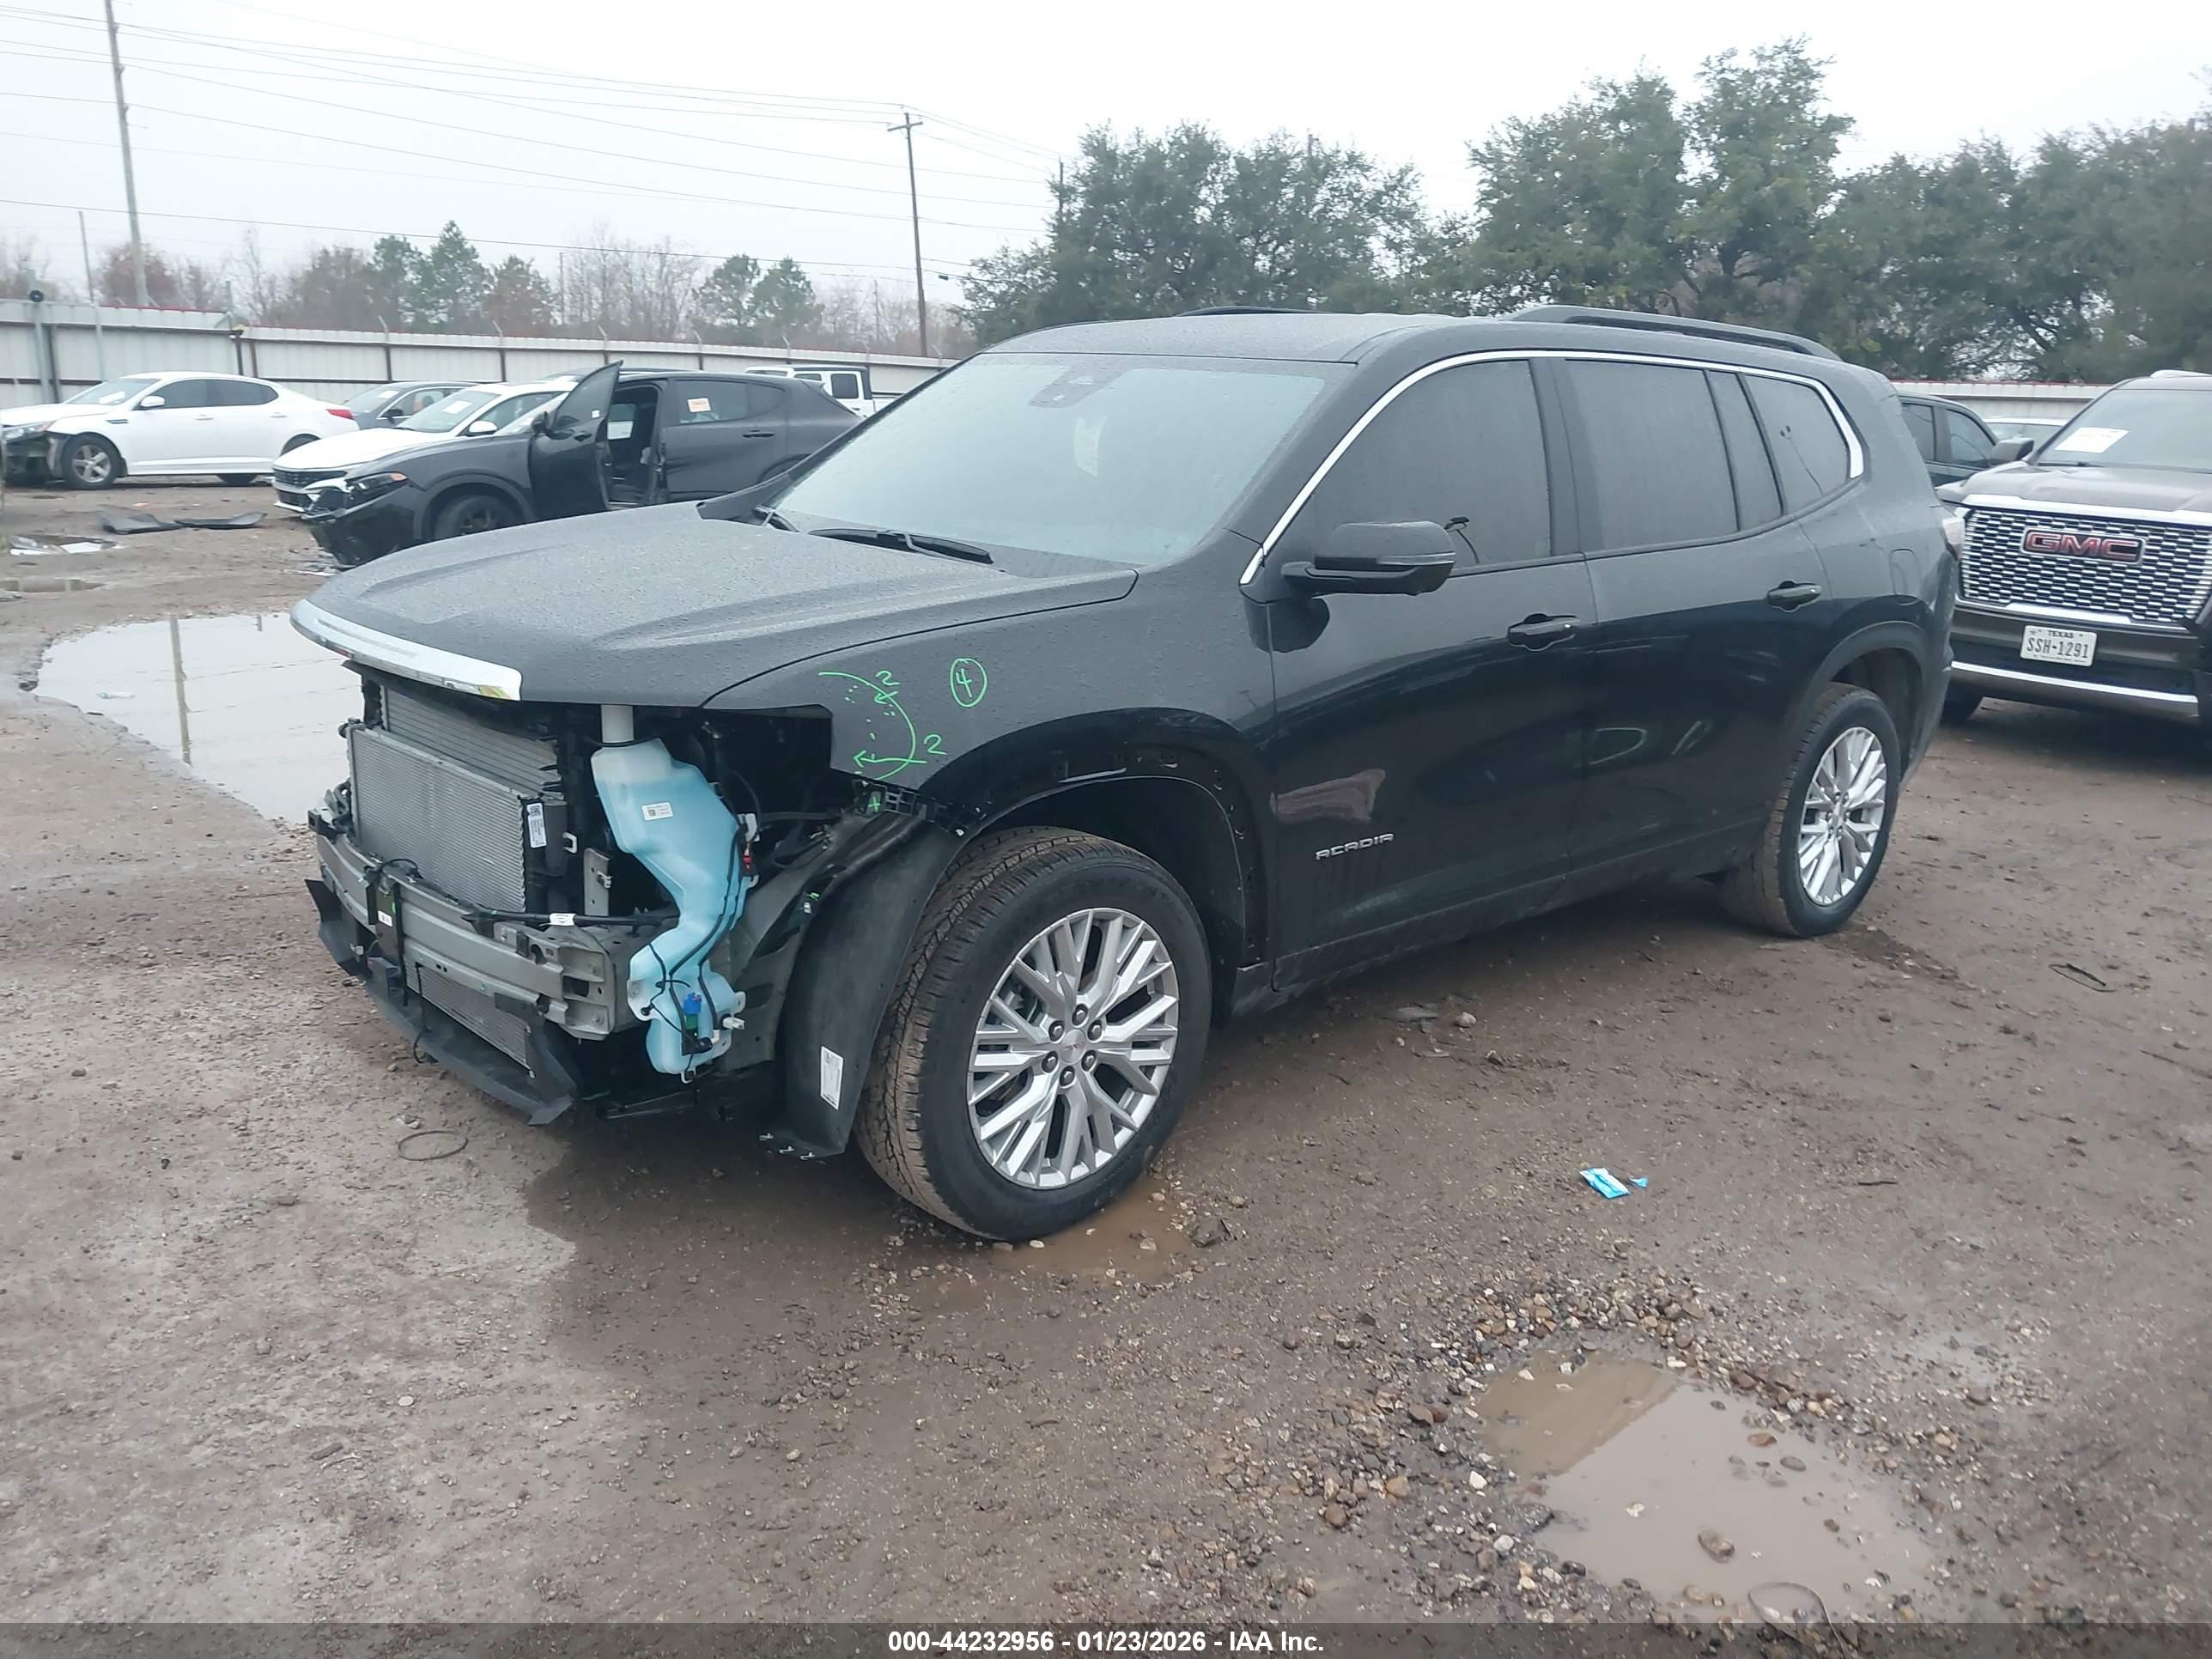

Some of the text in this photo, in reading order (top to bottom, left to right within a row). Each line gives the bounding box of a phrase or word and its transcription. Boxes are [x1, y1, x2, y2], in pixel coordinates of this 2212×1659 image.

[2025, 531, 2140, 561] GMC
[2047, 629, 2074, 639] TEXAS
[875, 670, 901, 686] 2
[955, 668, 973, 698] 4
[923, 734, 948, 756] 2
[1316, 833, 1395, 860] ACADIA
